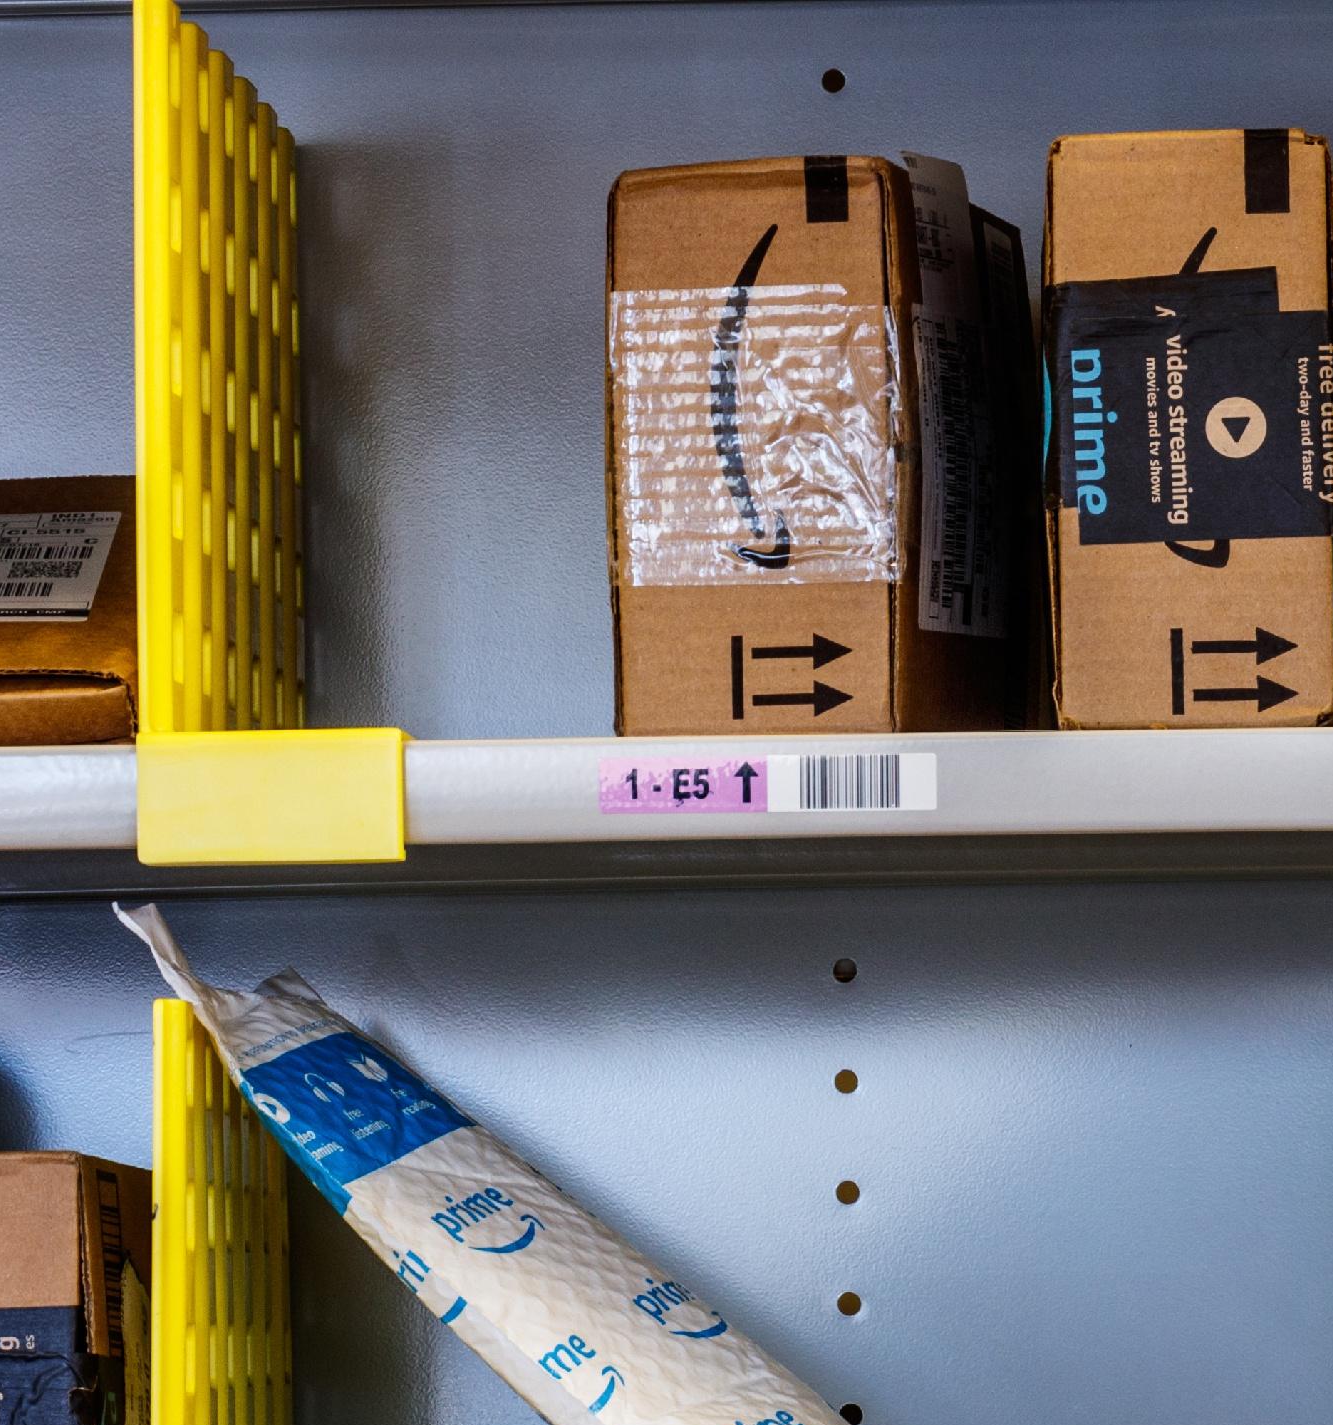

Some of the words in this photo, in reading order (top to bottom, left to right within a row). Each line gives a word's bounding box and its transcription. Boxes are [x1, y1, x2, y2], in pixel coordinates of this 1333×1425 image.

[1146, 357, 1159, 409] movies
[1166, 335, 1188, 399] video
[1298, 357, 1312, 416] two-day
[1070, 348, 1118, 515] prime
[1148, 411, 1158, 437] and
[1149, 440, 1160, 456] tv
[1301, 421, 1314, 447] and
[1150, 458, 1162, 503] shows
[1168, 405, 1193, 524] streaming
[1301, 450, 1314, 492] faster
[625, 768, 638, 799] 1
[673, 768, 710, 799] E5
[431, 1186, 514, 1243] prime
